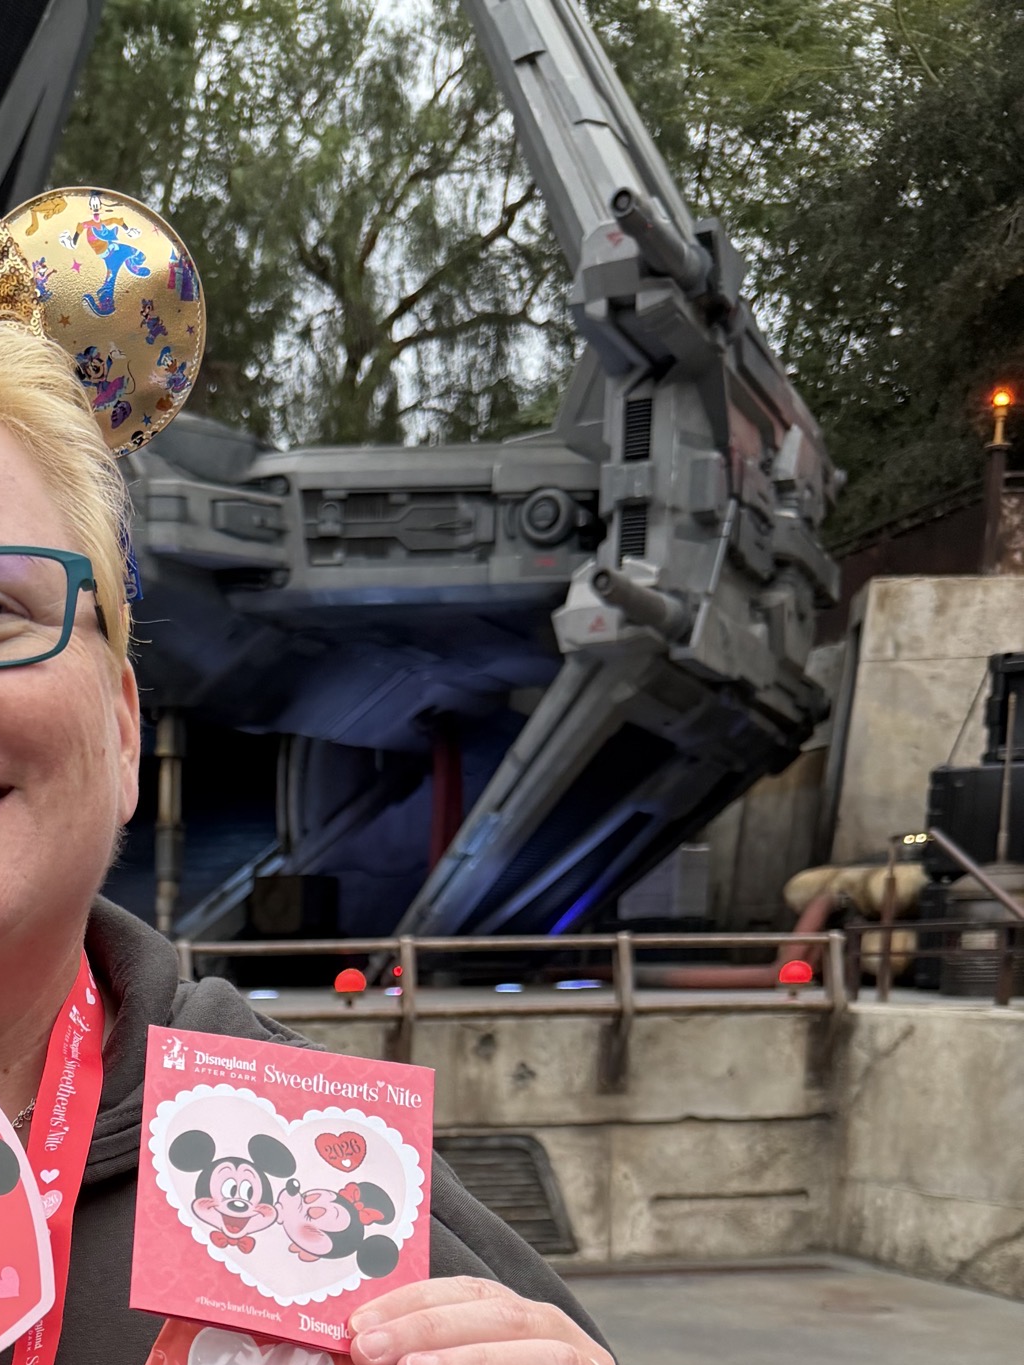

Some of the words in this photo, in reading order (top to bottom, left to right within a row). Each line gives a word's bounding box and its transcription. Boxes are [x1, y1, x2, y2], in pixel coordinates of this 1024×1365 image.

[193, 1050, 257, 1072] Disneyland
[194, 1066, 226, 1078] AFTER
[230, 1071, 257, 1082] DARK
[386, 1084, 423, 1109] Nite
[44, 1129, 67, 1152] Nite
[324, 1138, 361, 1160] 2026
